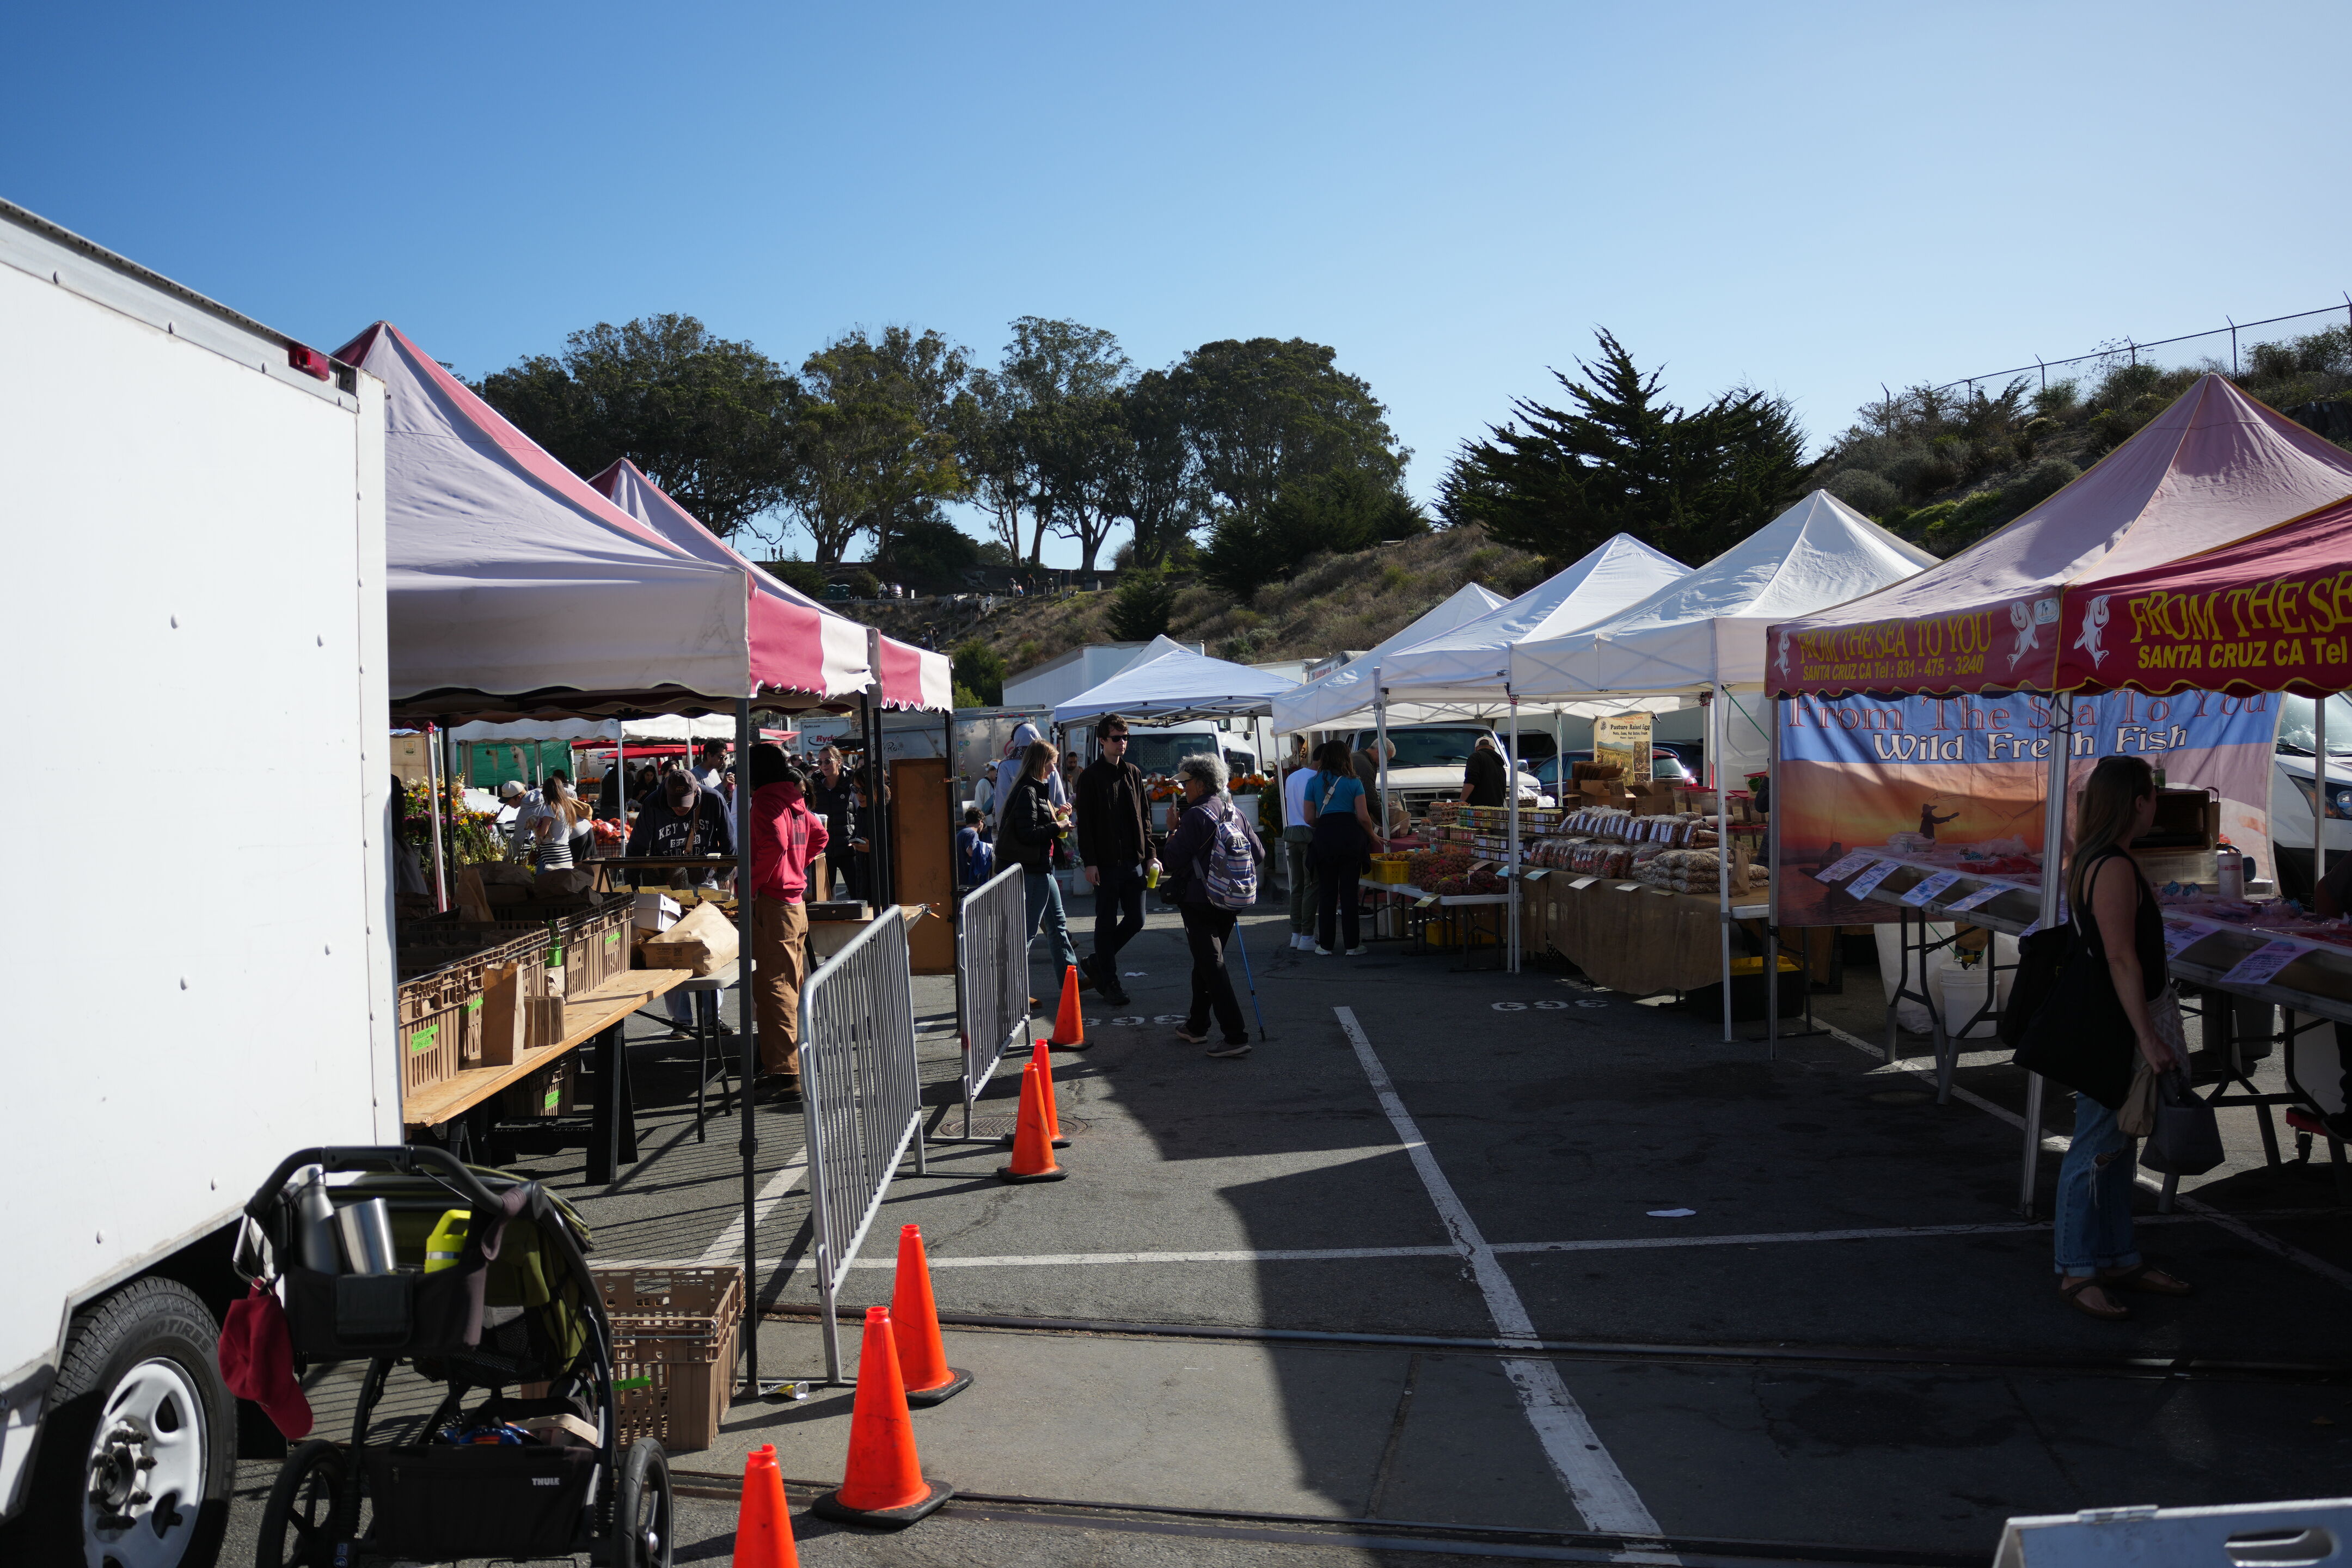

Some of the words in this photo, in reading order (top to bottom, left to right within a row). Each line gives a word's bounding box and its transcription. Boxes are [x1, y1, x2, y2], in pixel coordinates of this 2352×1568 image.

[2128, 591, 2224, 644] FROM
[2225, 578, 2308, 638] THE
[1797, 628, 1839, 665] FROM
[1841, 624, 1873, 661] THE
[1875, 618, 1909, 659] SEA
[1914, 618, 1941, 657] TO
[1946, 611, 1993, 654] YOU
[2137, 644, 2202, 669] SANTA
[2208, 640, 2268, 668] CRUZ
[2274, 639, 2306, 666] CA
[2311, 635, 2348, 665] Tel
[1803, 664, 1830, 681] SANTA
[1832, 662, 1857, 681] CRUZ
[1859, 661, 1872, 680] CA
[1896, 659, 1915, 678] 831
[1924, 658, 1945, 676] 475
[1955, 654, 1984, 675] 3240
[1787, 692, 1904, 731] From
[1921, 695, 2010, 731] The
[2028, 694, 2098, 728] Sa
[2114, 689, 2170, 724] To
[2192, 688, 2267, 718] You
[1873, 733, 1963, 761] Wild
[1987, 730, 2094, 759] Freh
[2115, 724, 2187, 754] Fish
[658, 823, 678, 841] KEY
[683, 819, 709, 832] WST
[167, 1319, 213, 1354] TIRES
[531, 1477, 560, 1486] THULE
